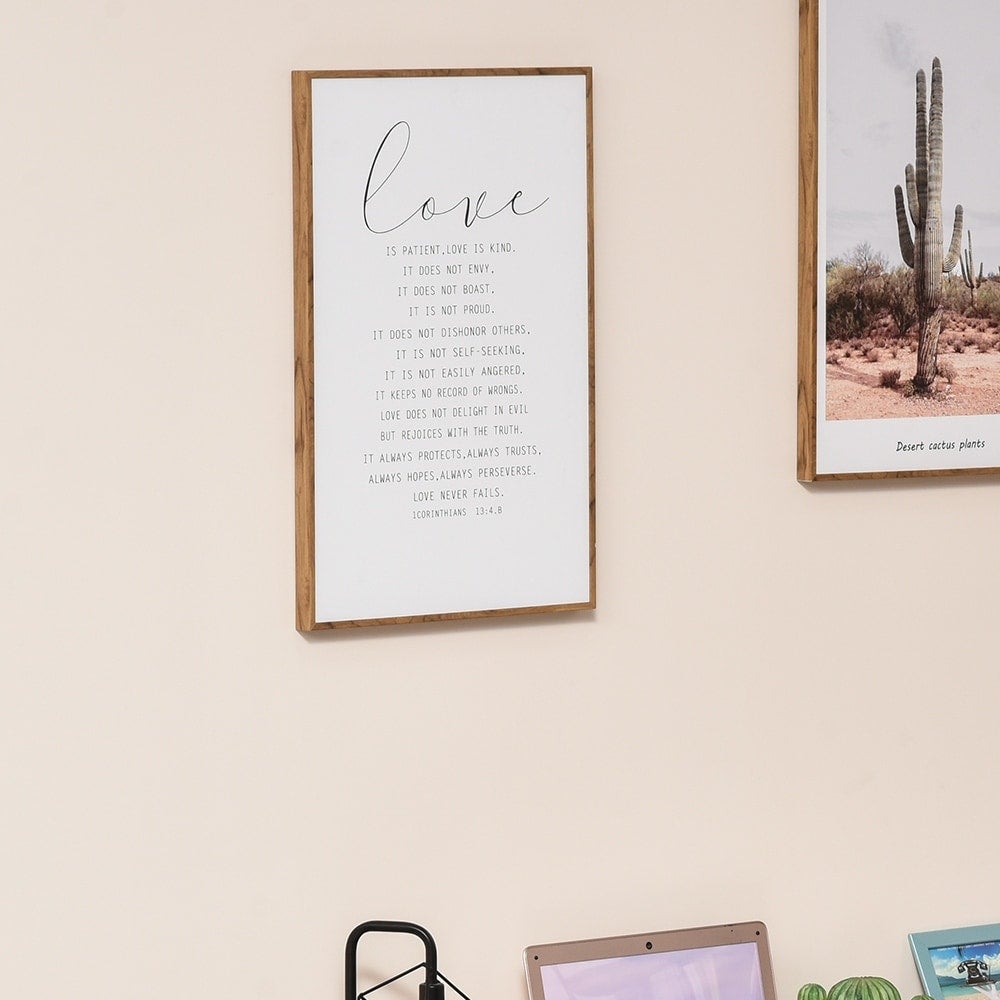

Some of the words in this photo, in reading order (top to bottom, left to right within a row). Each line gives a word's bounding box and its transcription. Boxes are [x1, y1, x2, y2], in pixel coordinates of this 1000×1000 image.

[363, 120, 550, 234] love
[386, 245, 397, 257] IS
[474, 242, 485, 254] IS
[403, 265, 413, 277] IT
[418, 264, 441, 276] DOES
[446, 263, 463, 275] NOT
[397, 286, 408, 297] IT
[413, 284, 436, 297] DOES
[440, 284, 458, 297] NOT
[409, 306, 420, 317] IT
[425, 305, 436, 317] IS
[441, 304, 458, 317] NOT
[373, 329, 384, 341] IT
[389, 328, 413, 340] DOES
[418, 327, 435, 339] NOT
[440, 325, 487, 338] DISHONOR
[396, 349, 407, 360] IT
[413, 348, 425, 360] IS
[429, 347, 447, 359] NOT
[385, 370, 396, 381] IT
[402, 369, 414, 382] IS
[418, 368, 436, 380] NOT
[441, 367, 475, 379] EASILY
[375, 390, 386, 401] IT
[390, 388, 417, 400] KEEPS
[421, 387, 433, 399] NO
[436, 386, 468, 398] RECORD
[472, 385, 483, 397] OF
[380, 409, 401, 421] LOVE
[406, 408, 427, 420] DOES
[431, 407, 448, 419] NOT
[452, 405, 489, 418] DELIGHT
[494, 405, 504, 416] IN
[508, 403, 529, 415] EVIL
[380, 430, 396, 442] BUT
[401, 427, 443, 441] REJOICES
[447, 426, 469, 438] WITH
[473, 425, 489, 437] THE
[895, 440, 925, 452] Desert
[928, 440, 956, 451] cactus
[958, 438, 986, 452] plants
[363, 453, 374, 464] IT
[379, 451, 413, 464] ALWAYS
[368, 472, 402, 485] ALWAYS
[413, 490, 435, 503] LOVE
[440, 488, 468, 501] NEVER
